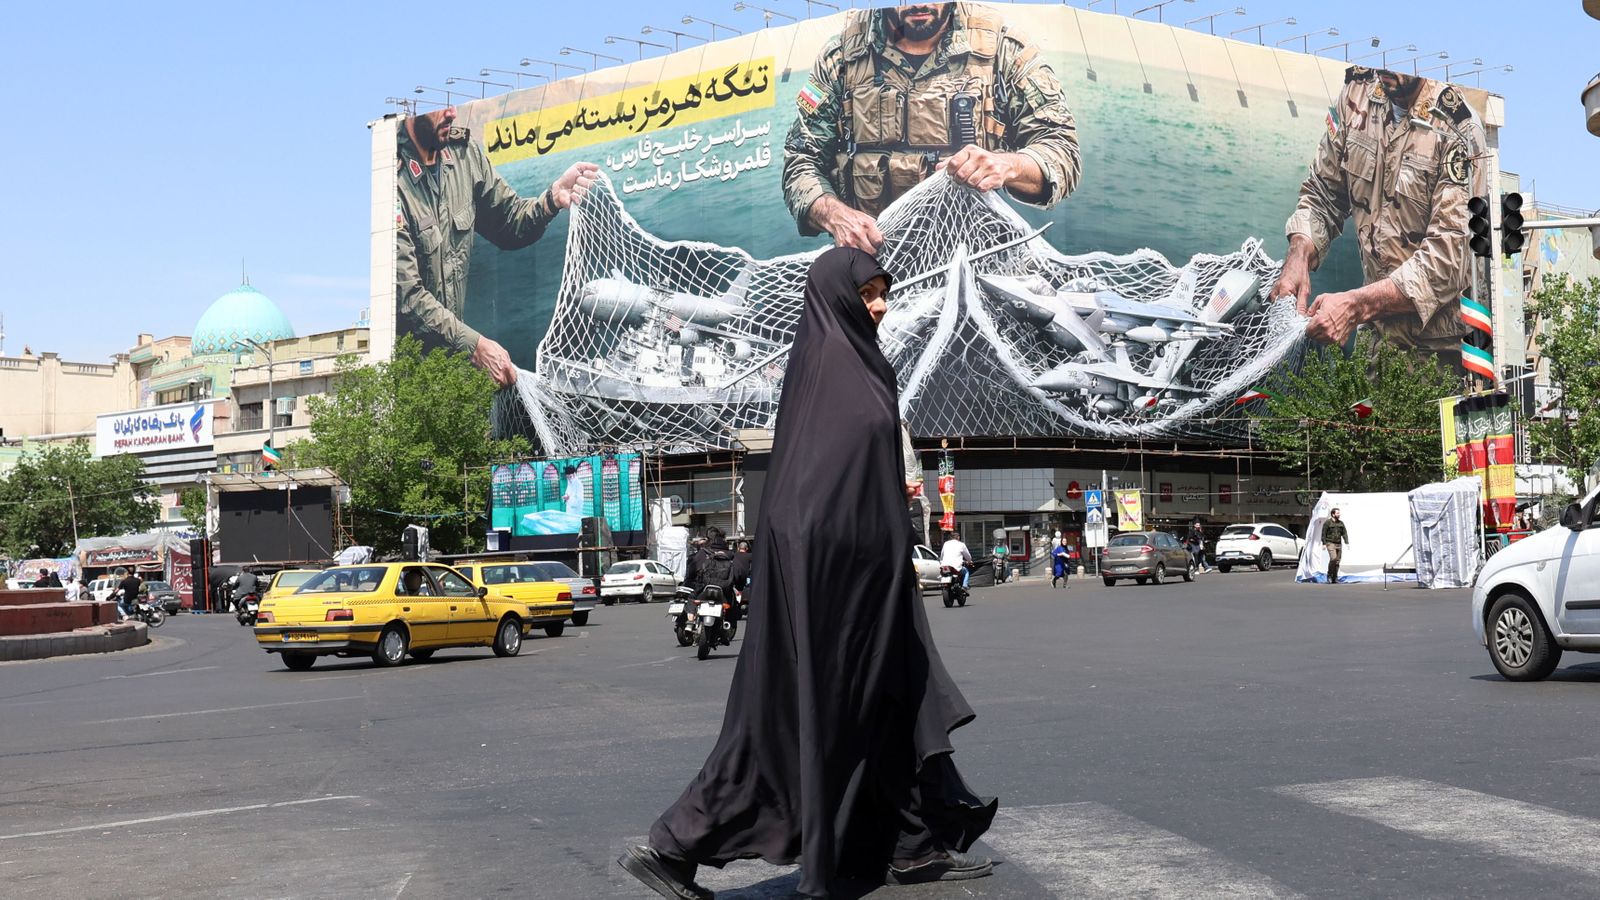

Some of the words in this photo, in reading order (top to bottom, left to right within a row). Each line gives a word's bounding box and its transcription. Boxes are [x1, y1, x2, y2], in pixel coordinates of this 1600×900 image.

[704, 63, 769, 102] تنگه
[575, 104, 637, 131] بسته
[635, 83, 702, 133] هرمز
[651, 127, 703, 166] خلیج
[700, 119, 771, 154] سراسر
[670, 154, 722, 191] شکار
[720, 141, 772, 182] قلمرو
[622, 166, 673, 194] ماست
[114, 416, 141, 435] کارگران
[141, 413, 162, 431] رفاه
[163, 412, 185, 430] بانک
[168, 433, 185, 443] BANK
